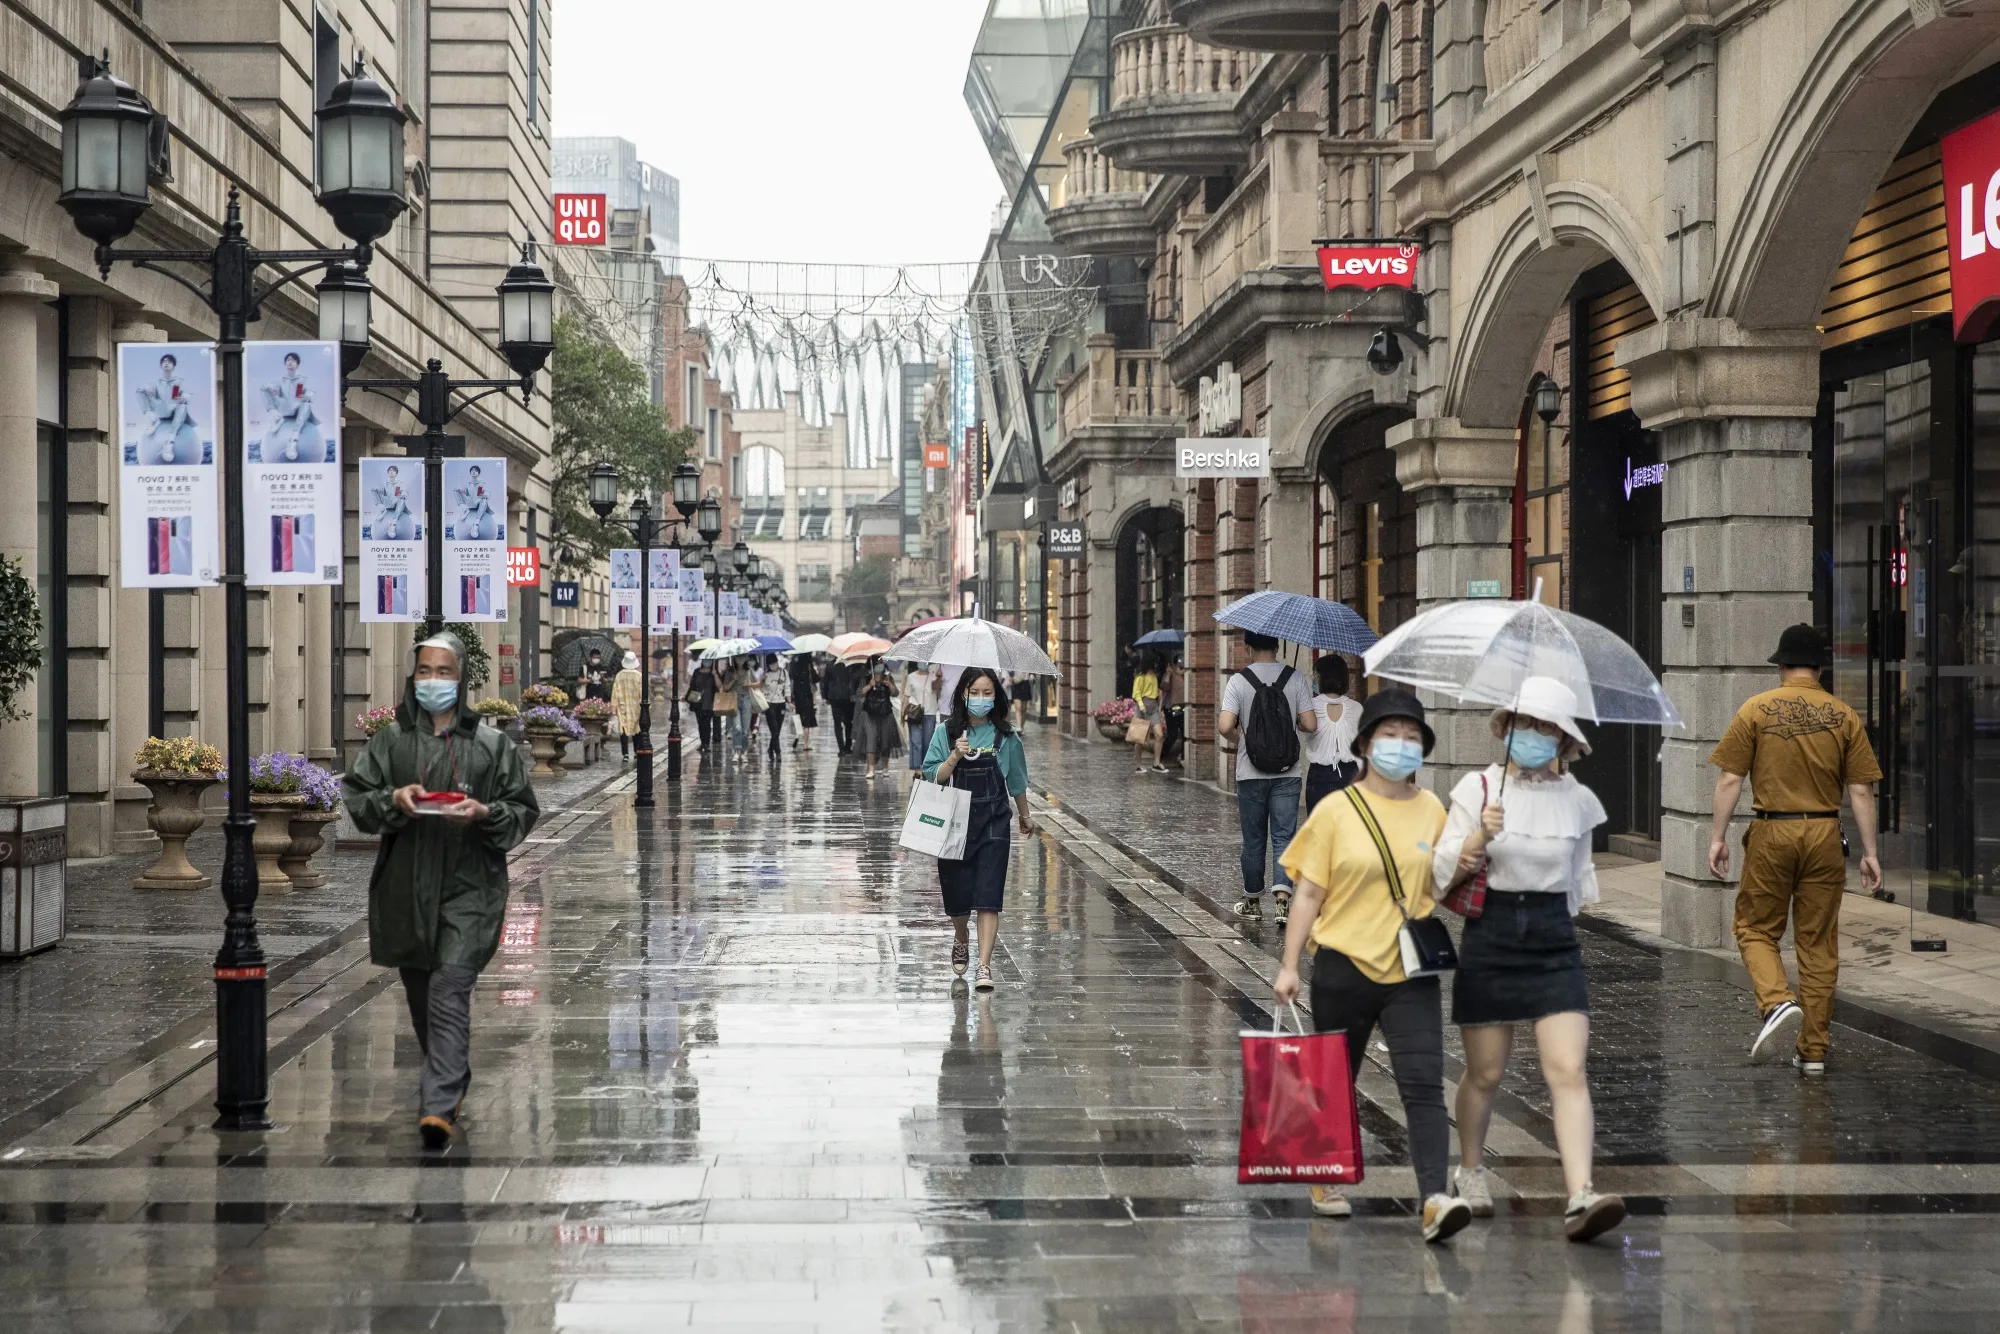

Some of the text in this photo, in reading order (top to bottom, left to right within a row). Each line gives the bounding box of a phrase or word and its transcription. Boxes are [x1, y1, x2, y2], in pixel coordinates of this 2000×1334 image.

[559, 198, 598, 218] UNI
[559, 219, 601, 241] QLO
[1018, 252, 1065, 288] UR
[1330, 256, 1409, 275] Levi's
[1181, 448, 1260, 469] Bershka
[1050, 528, 1082, 544] P&B
[507, 551, 532, 566] UNI
[507, 567, 535, 583] QLO
[556, 588, 574, 600] GAP
[1248, 1164, 1344, 1176] URBAN REVIVO
